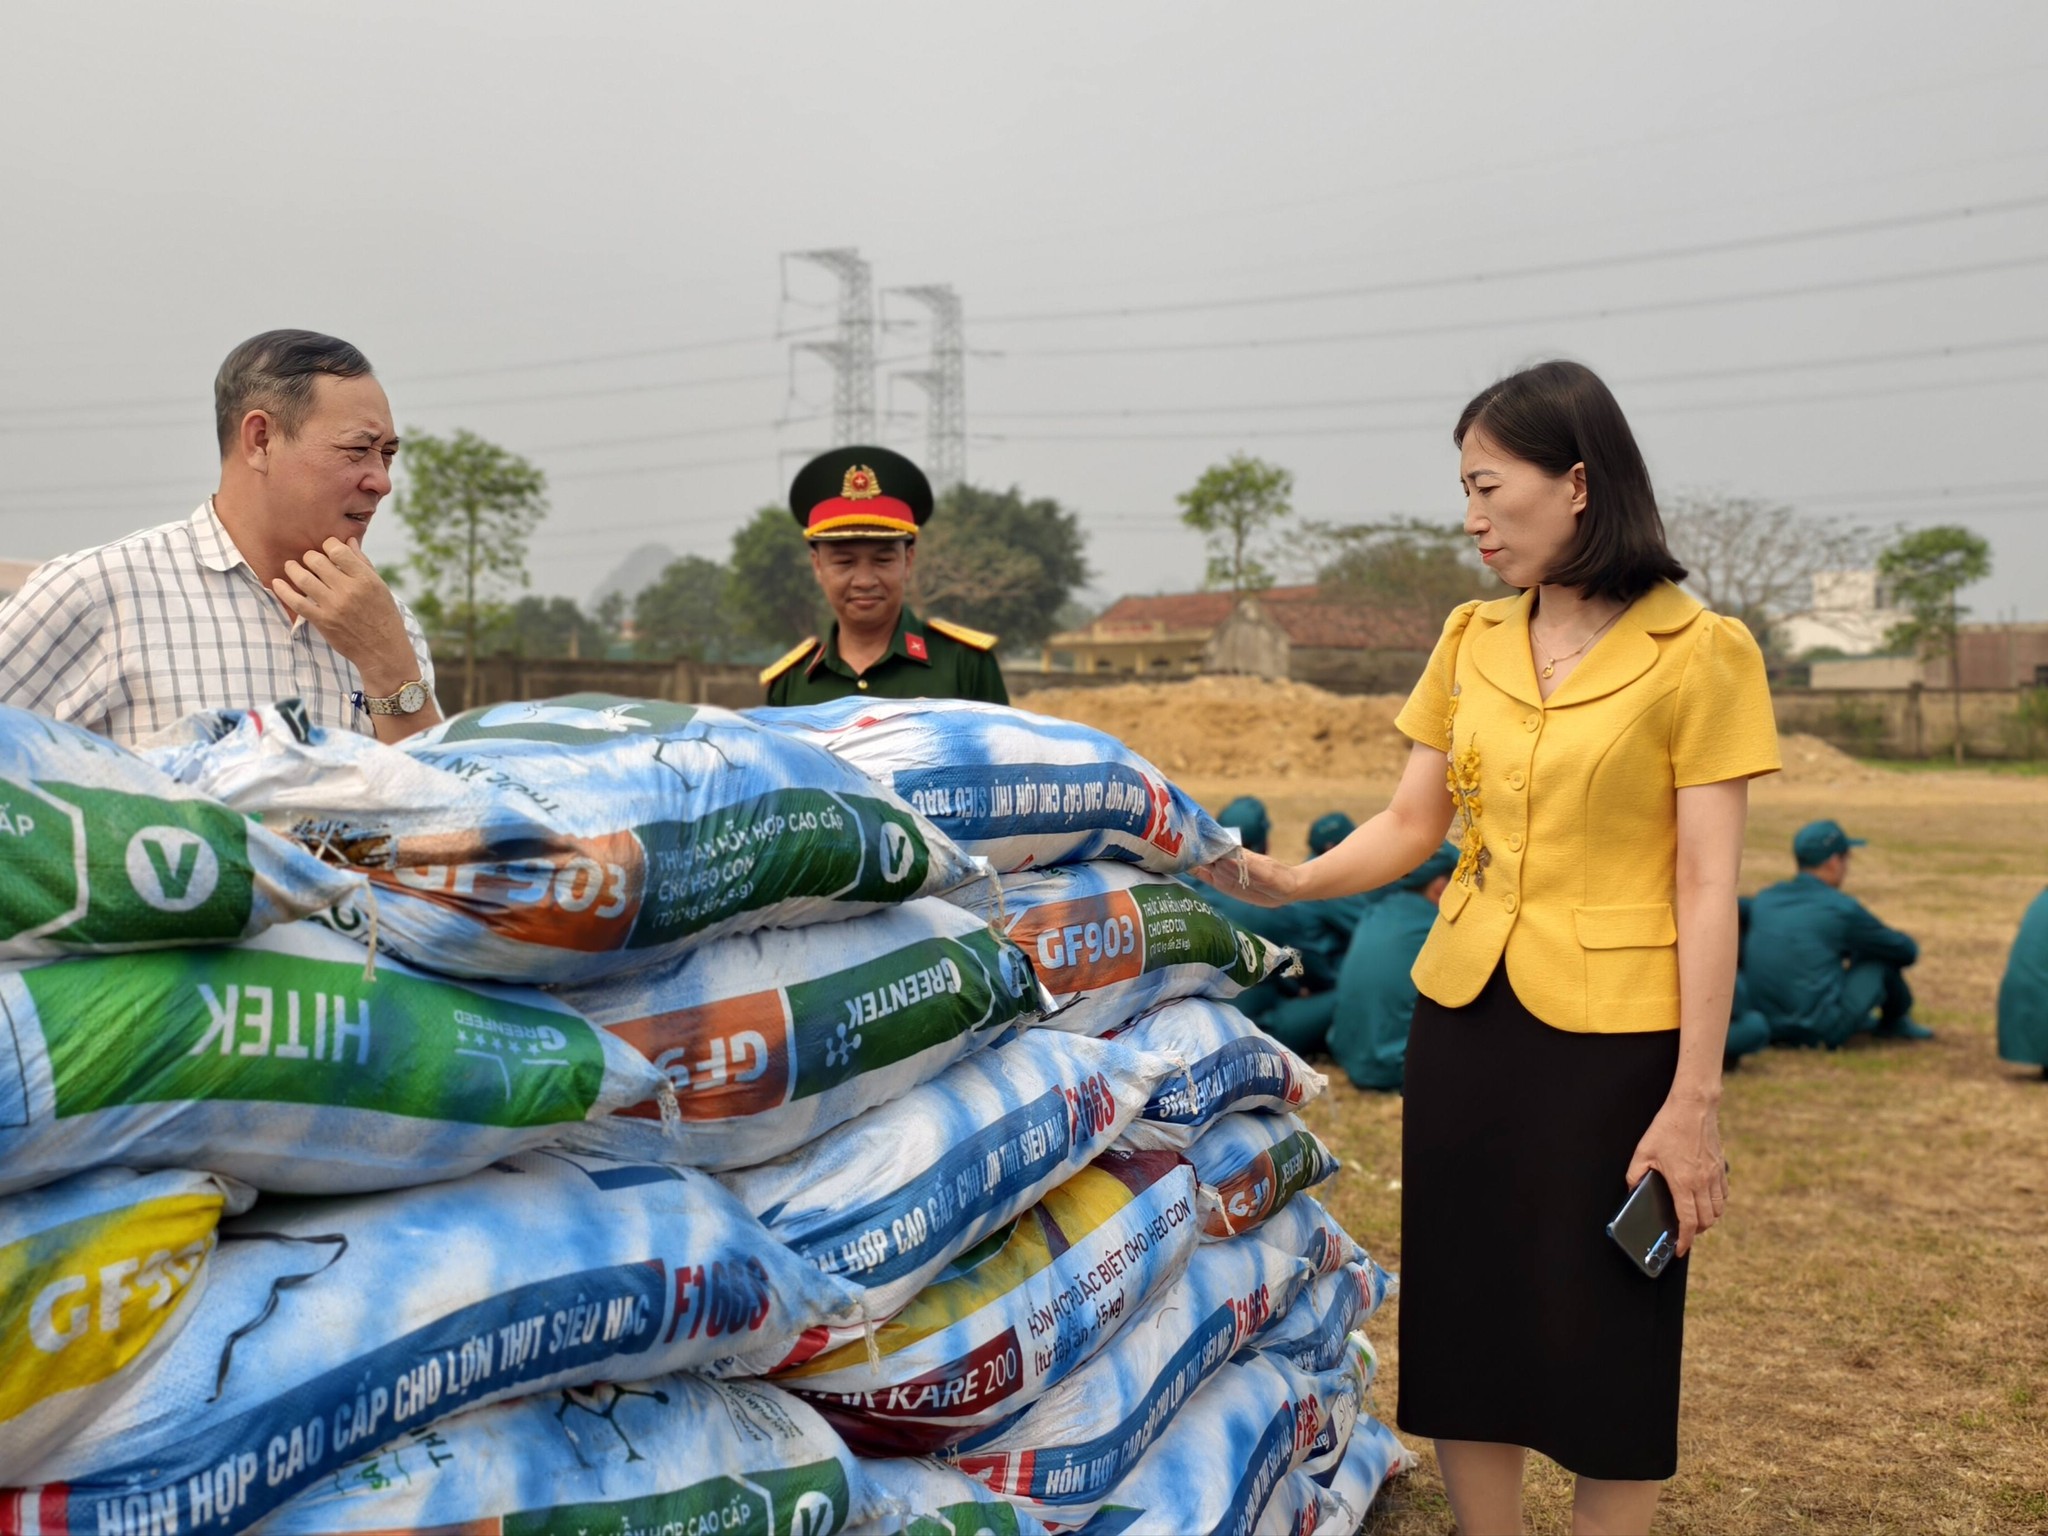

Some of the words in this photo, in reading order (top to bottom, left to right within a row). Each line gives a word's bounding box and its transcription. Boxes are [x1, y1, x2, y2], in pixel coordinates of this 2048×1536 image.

[956, 786, 987, 826] SIÊU
[990, 779, 1012, 816] THỊT
[1016, 777, 1036, 817] LỢN
[1039, 782, 1060, 814] CHO
[1063, 783, 1083, 826] CẤP
[1083, 781, 1103, 812] CAO
[753, 813, 786, 843] HỢP
[789, 811, 818, 833] CAO
[821, 804, 844, 832] CẤP
[141, 838, 201, 899] V
[1037, 915, 1136, 971] GF903
[1148, 922, 1162, 938] CHO
[1161, 918, 1175, 935] HEO
[844, 957, 962, 1031] GREENTEK
[187, 983, 371, 1065] HITEK
[454, 1009, 567, 1052] GREENFEED
[892, 1206, 928, 1255] CAO
[927, 1171, 955, 1233] CẤP
[956, 1164, 981, 1210] CHO
[982, 1148, 1002, 1195] LỢN
[1020, 1120, 1046, 1167] SIÊU
[1097, 1249, 1128, 1286] BIỆT
[1124, 1232, 1149, 1264] CHO
[1145, 1215, 1169, 1246] HEO
[1165, 1196, 1192, 1228] CON
[887, 1363, 978, 1411] KARE
[983, 1342, 1018, 1400] 200
[188, 1453, 259, 1527] HỢP
[266, 1417, 326, 1488] CAO
[333, 1370, 389, 1452] CẤP
[393, 1356, 443, 1423] CHO
[446, 1333, 494, 1398] LỢN
[499, 1315, 546, 1371] THỊT
[549, 1293, 602, 1354] SIÊU
[602, 1294, 650, 1345] NẠC
[1045, 1453, 1085, 1496] HỖN
[1089, 1449, 1119, 1488] HỢP
[1119, 1428, 1142, 1470] CAO
[687, 1510, 719, 1536] CAO
[720, 1494, 751, 1531] CẤP
